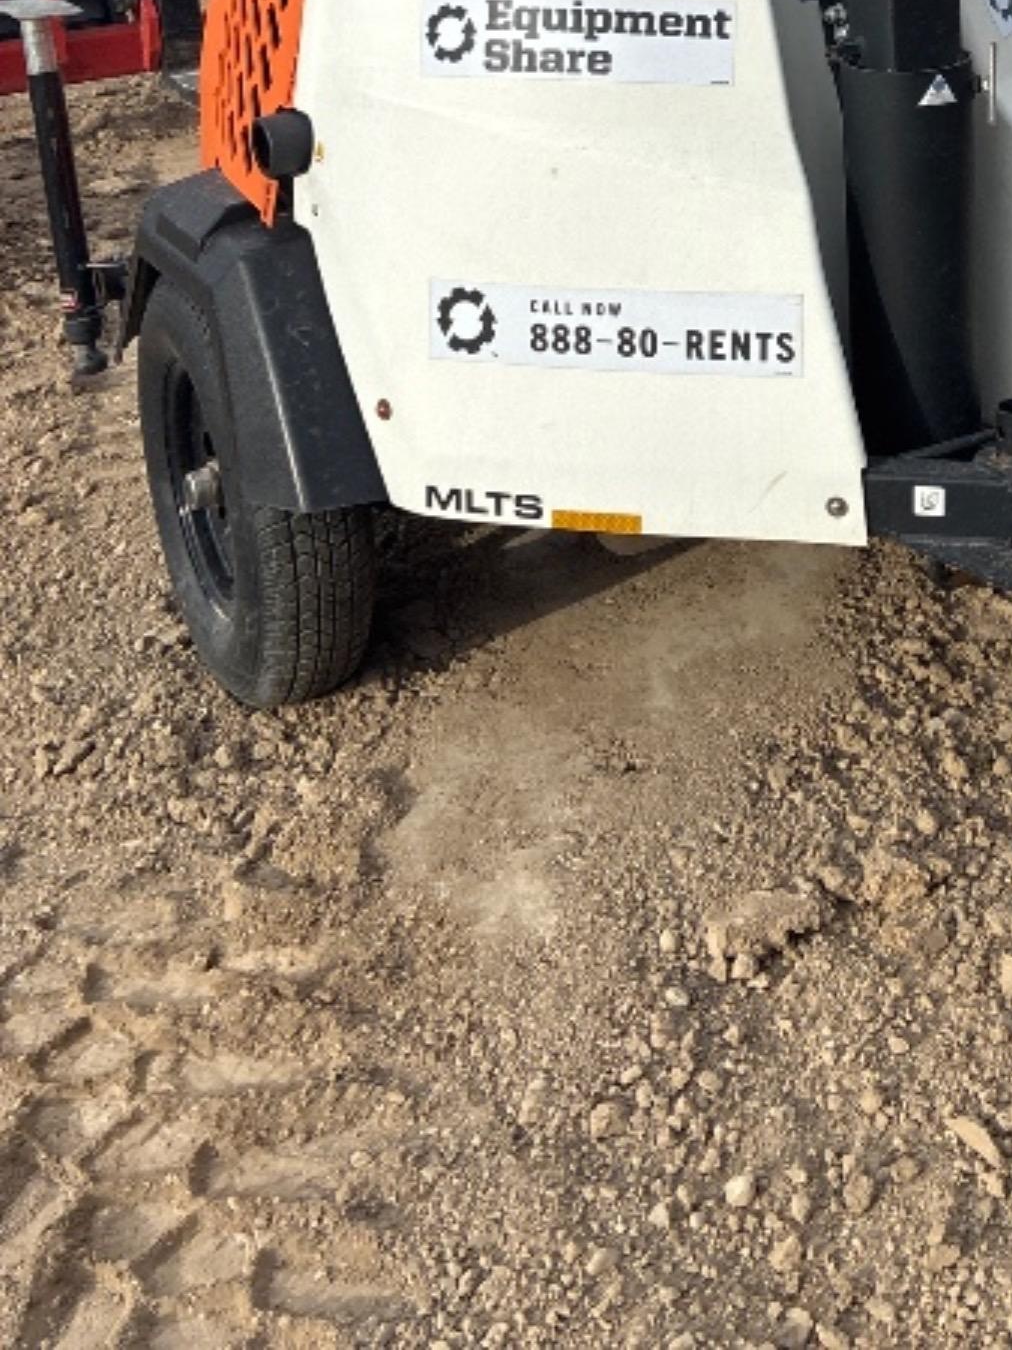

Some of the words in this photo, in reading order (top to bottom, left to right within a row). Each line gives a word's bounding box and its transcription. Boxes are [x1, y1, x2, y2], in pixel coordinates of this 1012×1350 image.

[483, 38, 612, 75] Share
[529, 299, 574, 316] CALL
[581, 302, 623, 318] NOW
[528, 323, 796, 363] 888-80-RENTS
[425, 484, 544, 520] MLTS
